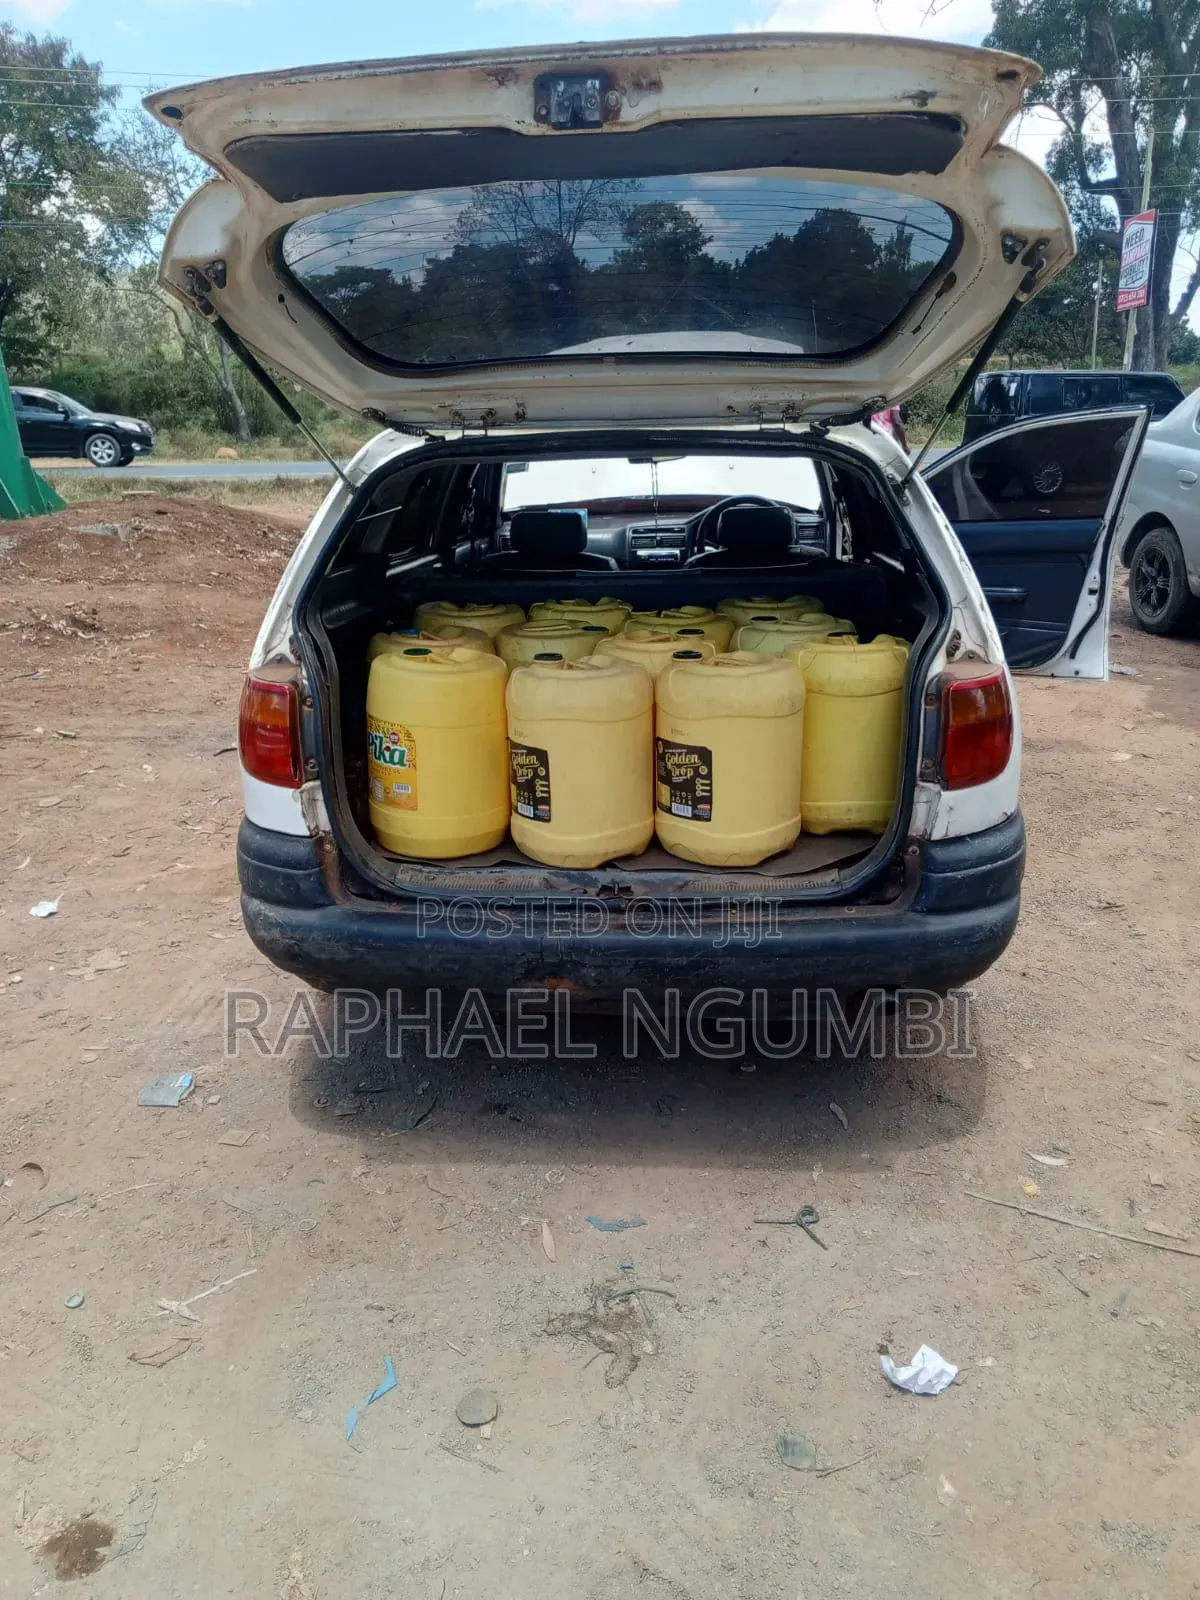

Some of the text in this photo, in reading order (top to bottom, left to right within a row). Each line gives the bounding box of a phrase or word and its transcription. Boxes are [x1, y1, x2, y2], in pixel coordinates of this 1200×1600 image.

[1124, 228, 1145, 250] NEED
[511, 752, 538, 770] Golden
[665, 752, 701, 770] Golden
[516, 765, 534, 780] Drop
[671, 766, 694, 780] Drop
